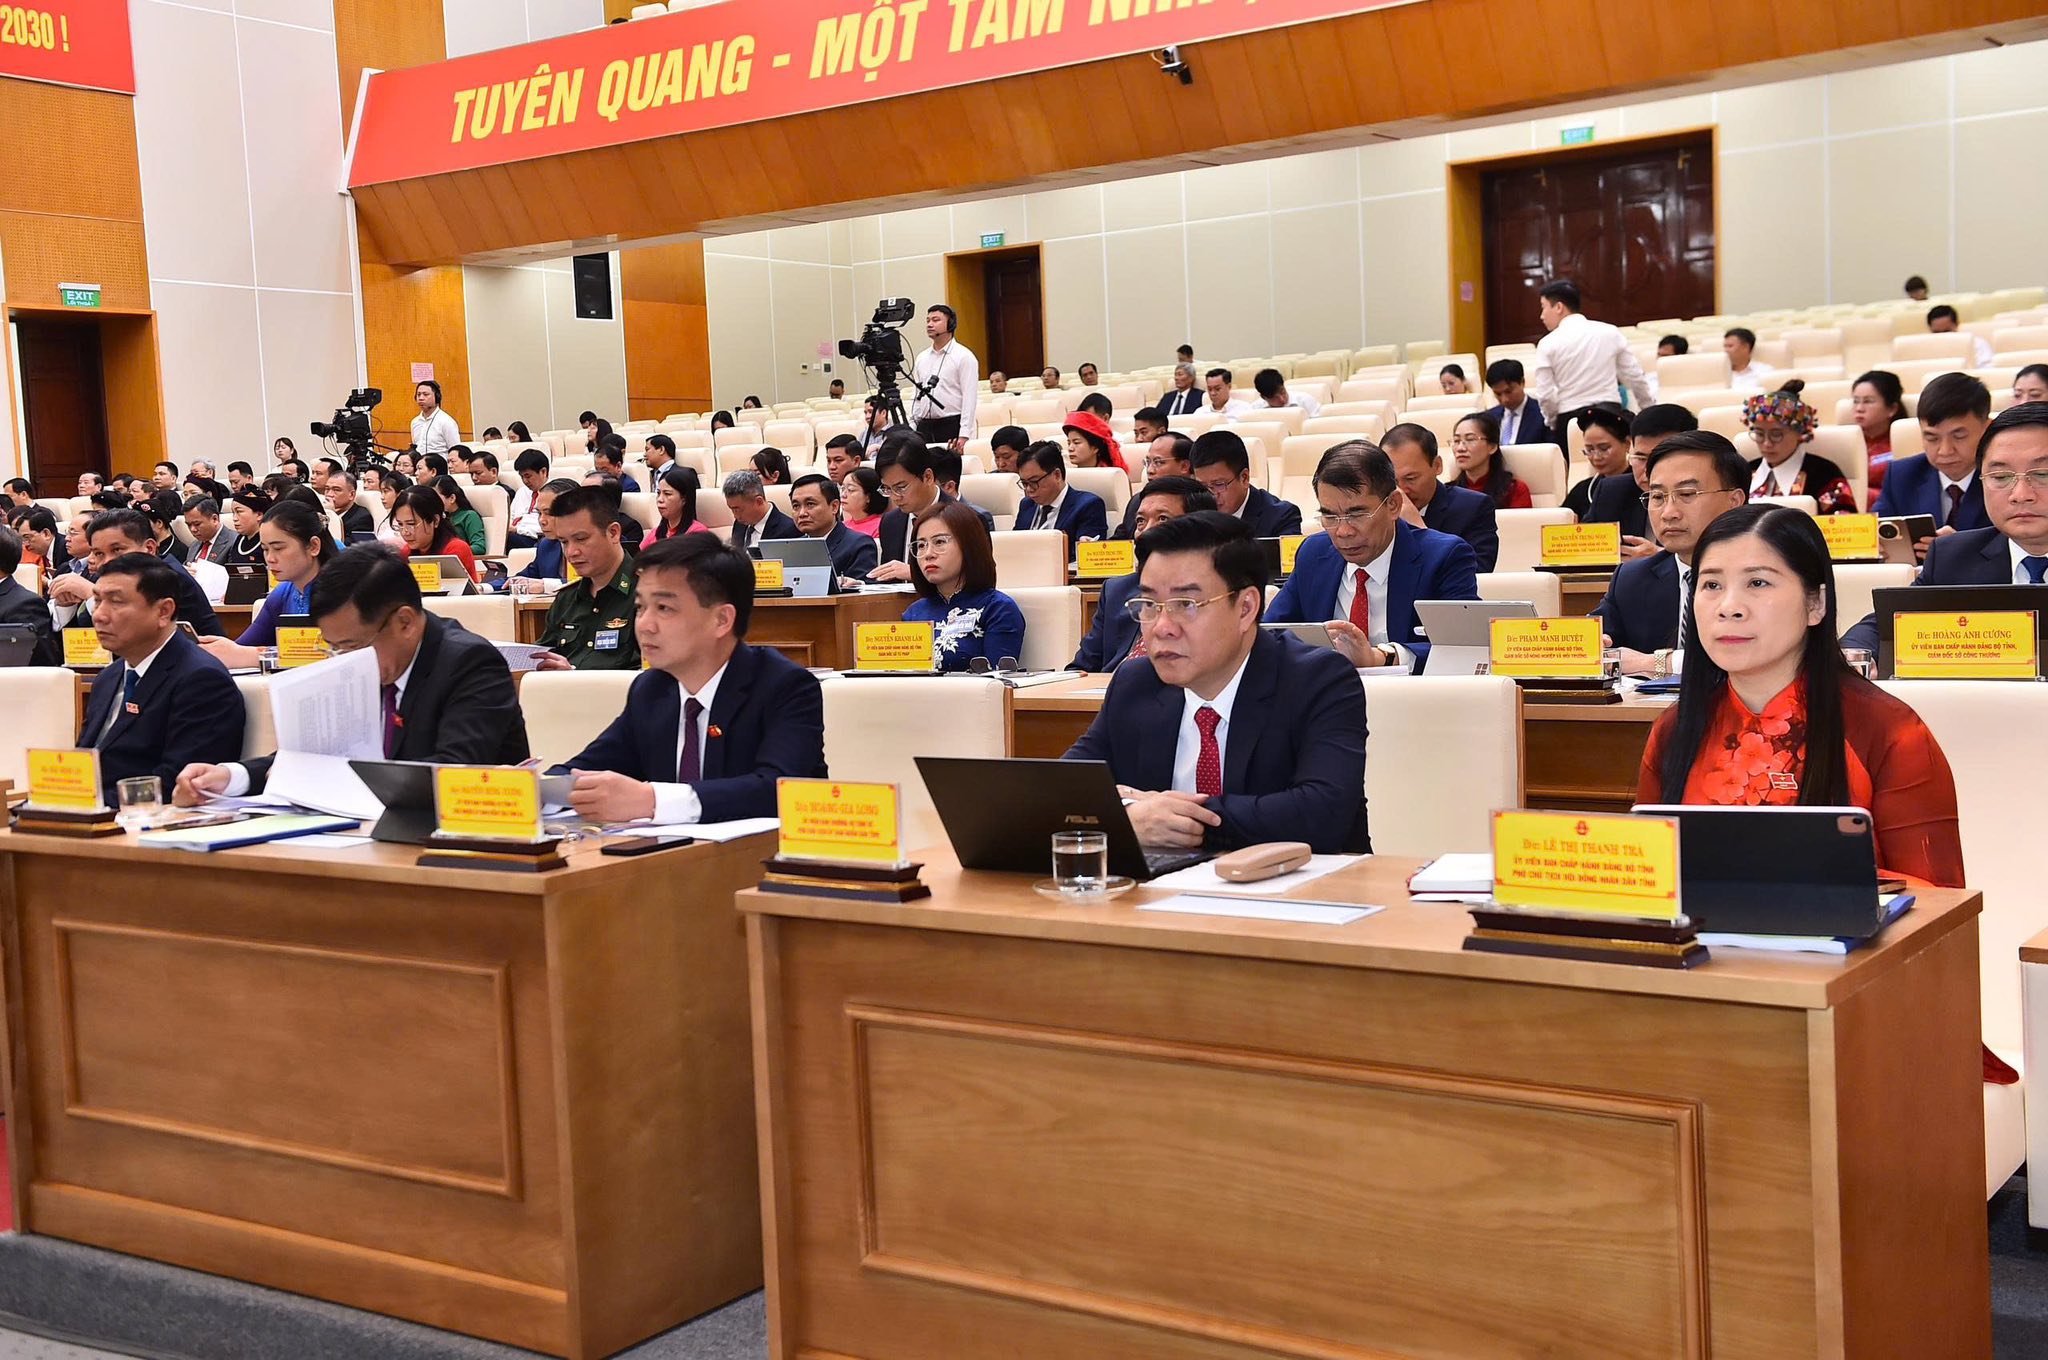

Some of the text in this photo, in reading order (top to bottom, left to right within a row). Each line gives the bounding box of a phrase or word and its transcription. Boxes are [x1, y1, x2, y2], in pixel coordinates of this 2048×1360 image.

[0, 4, 70, 52] 2030 !
[450, 63, 585, 144] TUYÊN
[596, 34, 756, 122] QUANG
[809, 0, 928, 82] MỘT
[66, 290, 94, 300] EXIT
[874, 634, 893, 642] NGUYỄN
[1519, 635, 1538, 644] PHẠM
[1540, 635, 1559, 644] MẠNH
[1562, 633, 1584, 643] DUYỆT
[1933, 630, 1961, 639] HOÀNG
[1065, 815, 1099, 824] ASUS
[1544, 837, 1557, 850] LÊ
[1560, 840, 1578, 854] THỊ
[1582, 842, 1619, 856] THANH
[1622, 843, 1644, 857] TRÀ
